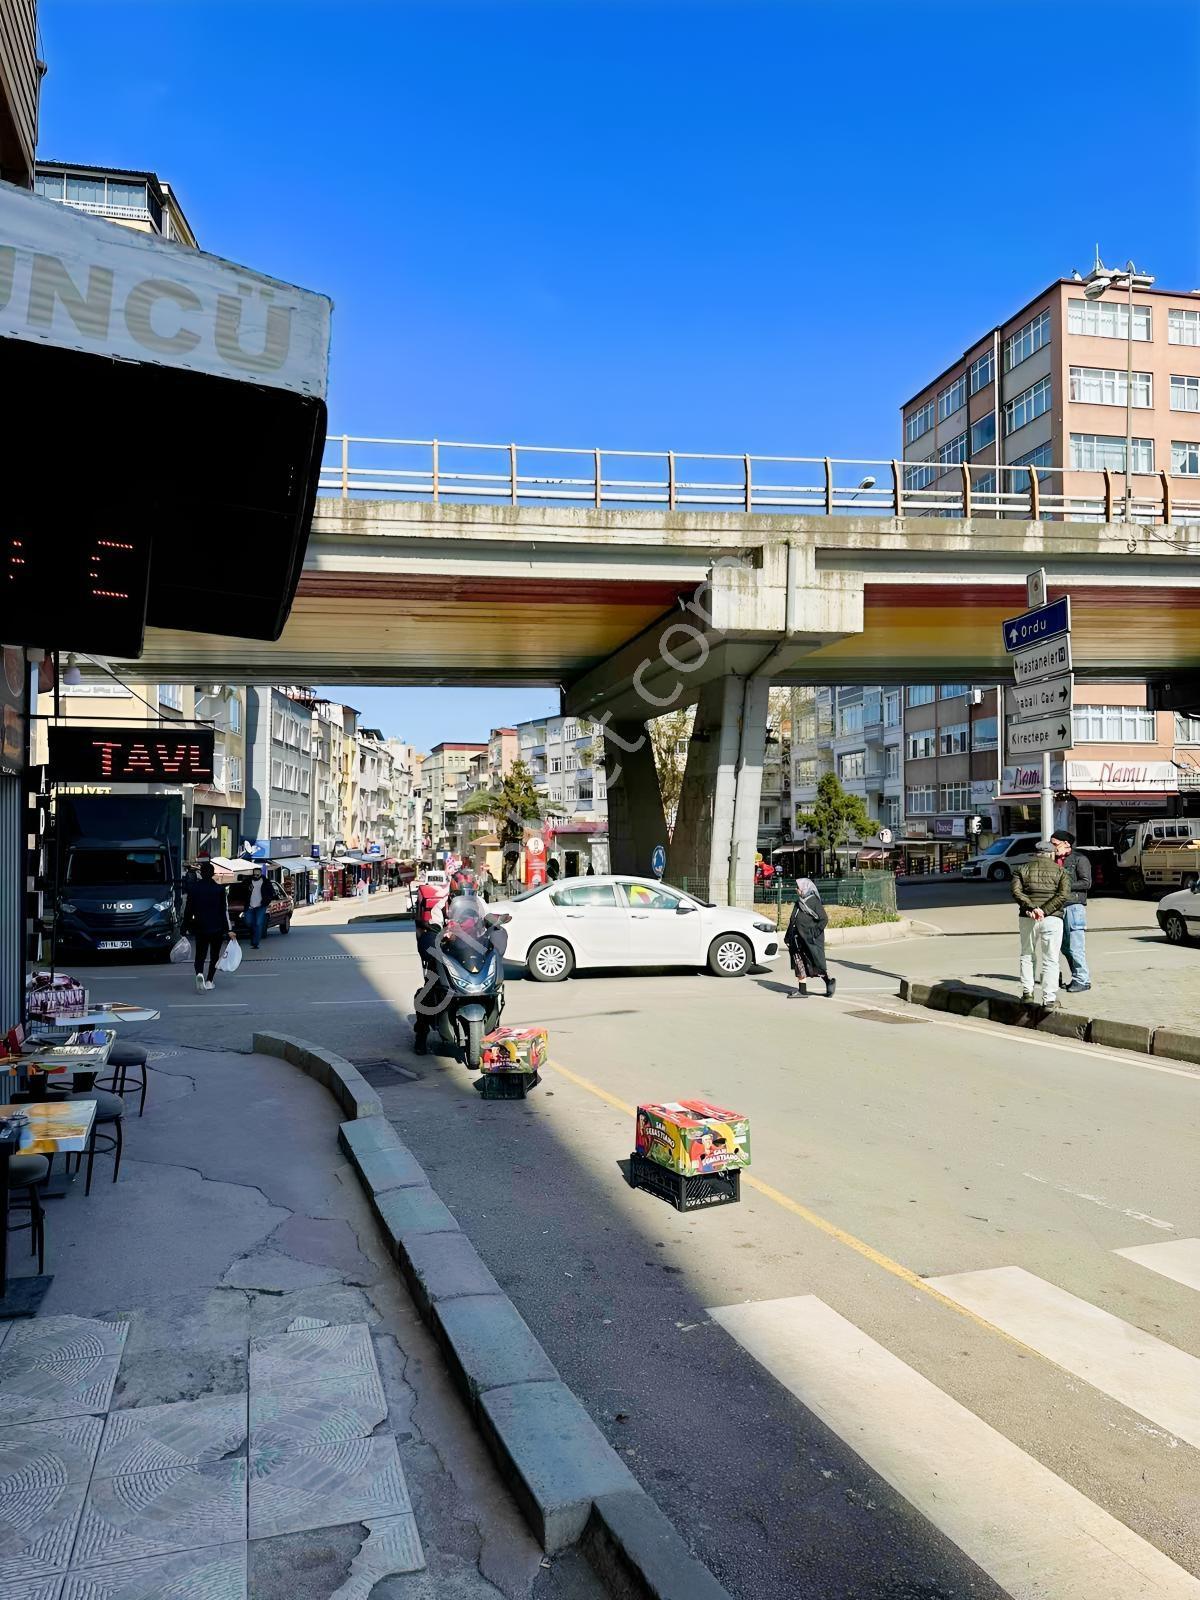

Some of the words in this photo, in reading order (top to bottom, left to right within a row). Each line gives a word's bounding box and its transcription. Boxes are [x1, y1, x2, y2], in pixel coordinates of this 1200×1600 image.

[0, 246, 292, 374] NCÜ
[1021, 619, 1047, 638] Ordu
[1019, 651, 1058, 675] Hastaneler
[1041, 690, 1055, 704] Cad
